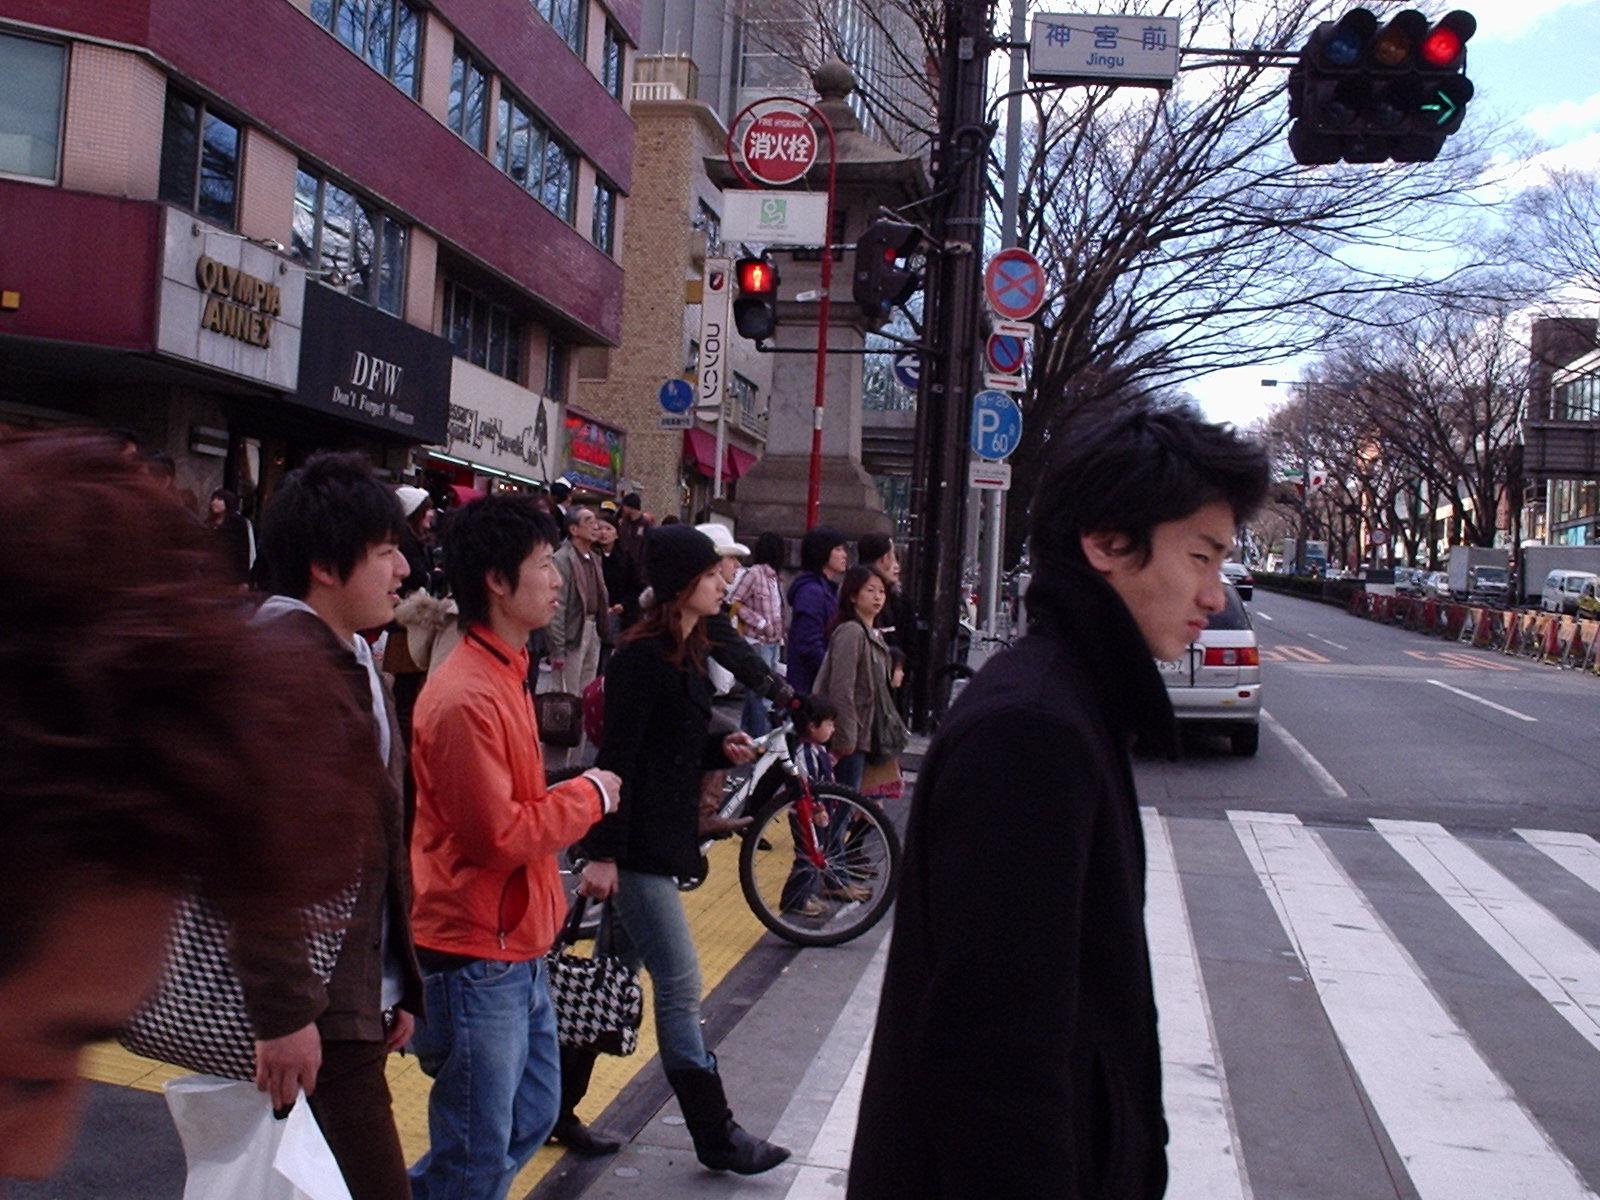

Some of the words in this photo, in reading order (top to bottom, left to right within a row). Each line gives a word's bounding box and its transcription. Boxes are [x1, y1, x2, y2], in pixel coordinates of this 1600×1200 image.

[1045, 23, 1167, 51] 神宮前
[1086, 53, 1125, 68] Jingu
[749, 131, 811, 162] 消火栓
[196, 255, 281, 316] OLYMPIA
[201, 299, 270, 349] ANNEX
[352, 351, 402, 395] DFW
[977, 408, 1000, 450] P
[991, 433, 1008, 452] 60
